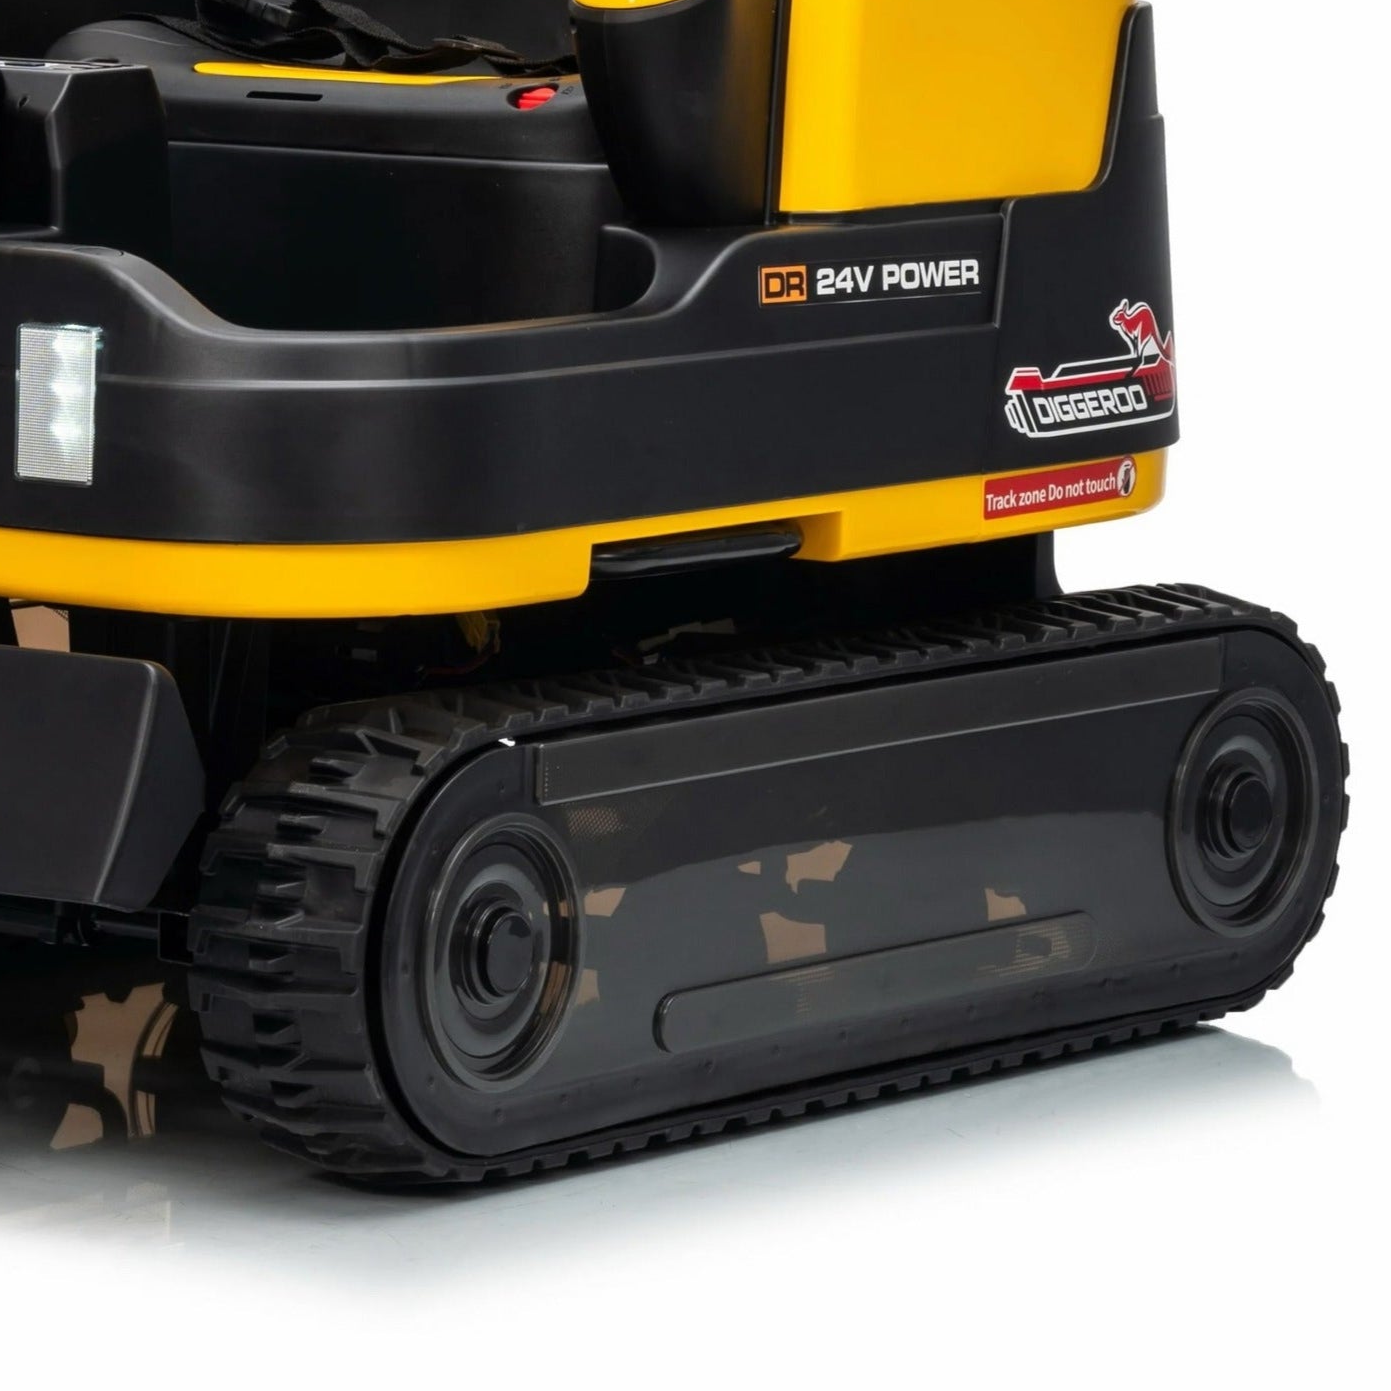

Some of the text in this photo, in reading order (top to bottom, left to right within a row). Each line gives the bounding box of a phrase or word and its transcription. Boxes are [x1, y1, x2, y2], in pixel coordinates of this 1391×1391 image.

[764, 259, 979, 299] DR 24V POWER
[1032, 384, 1148, 425] DIGGEROO
[986, 472, 1116, 511] Track zone Do not touch
